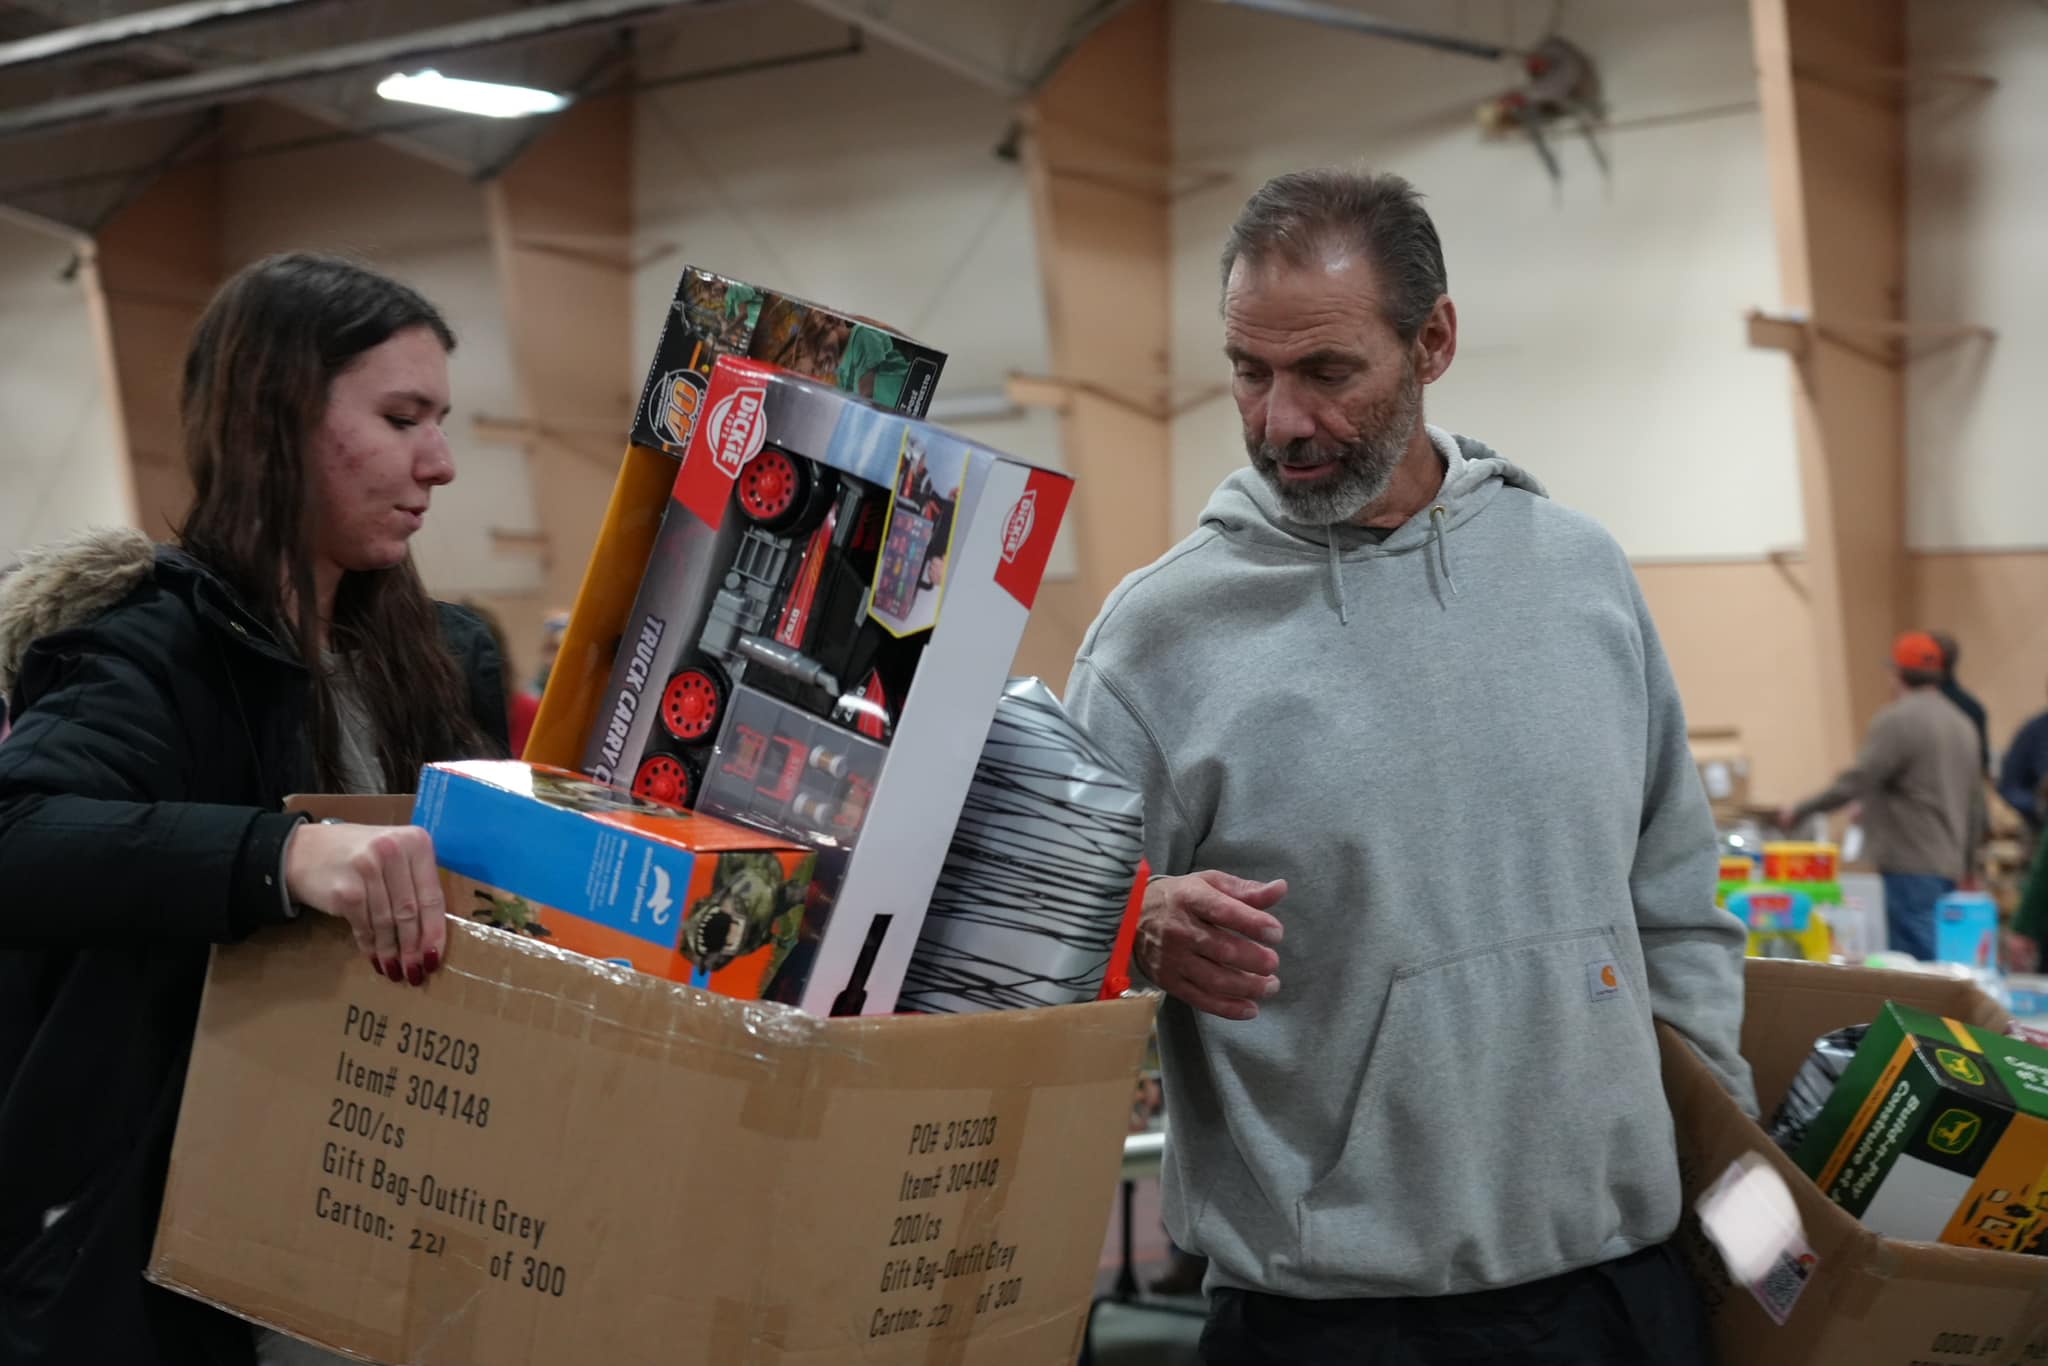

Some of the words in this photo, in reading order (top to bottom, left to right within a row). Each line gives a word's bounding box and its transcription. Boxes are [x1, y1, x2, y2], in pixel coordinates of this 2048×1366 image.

[665, 377, 699, 445] 40
[625, 615, 665, 693] TRUCK
[601, 689, 639, 768] CARRY
[344, 1004, 389, 1047] PO#
[397, 1021, 481, 1076] 315203
[328, 1097, 407, 1149] 200/cs
[336, 1050, 399, 1098] Item#
[405, 1073, 491, 1128] 304148
[908, 1121, 940, 1155] PO#
[943, 1115, 999, 1152] 315203
[322, 1141, 366, 1185] Gift
[371, 1158, 489, 1226] Bag-Outfit
[492, 1199, 547, 1251] Grey
[898, 1165, 942, 1203] Item#
[946, 1158, 1000, 1194] 304148
[315, 1187, 395, 1242] Carton:
[489, 1252, 514, 1282] of
[520, 1255, 567, 1298] 300
[889, 1213, 943, 1248] 200/cs
[880, 1259, 913, 1293] Gift
[912, 1243, 985, 1291] Bag-Outfit
[985, 1240, 1018, 1275] Grey
[868, 1304, 922, 1338] Carton:
[975, 1284, 994, 1314] of
[994, 1277, 1023, 1311] 300
